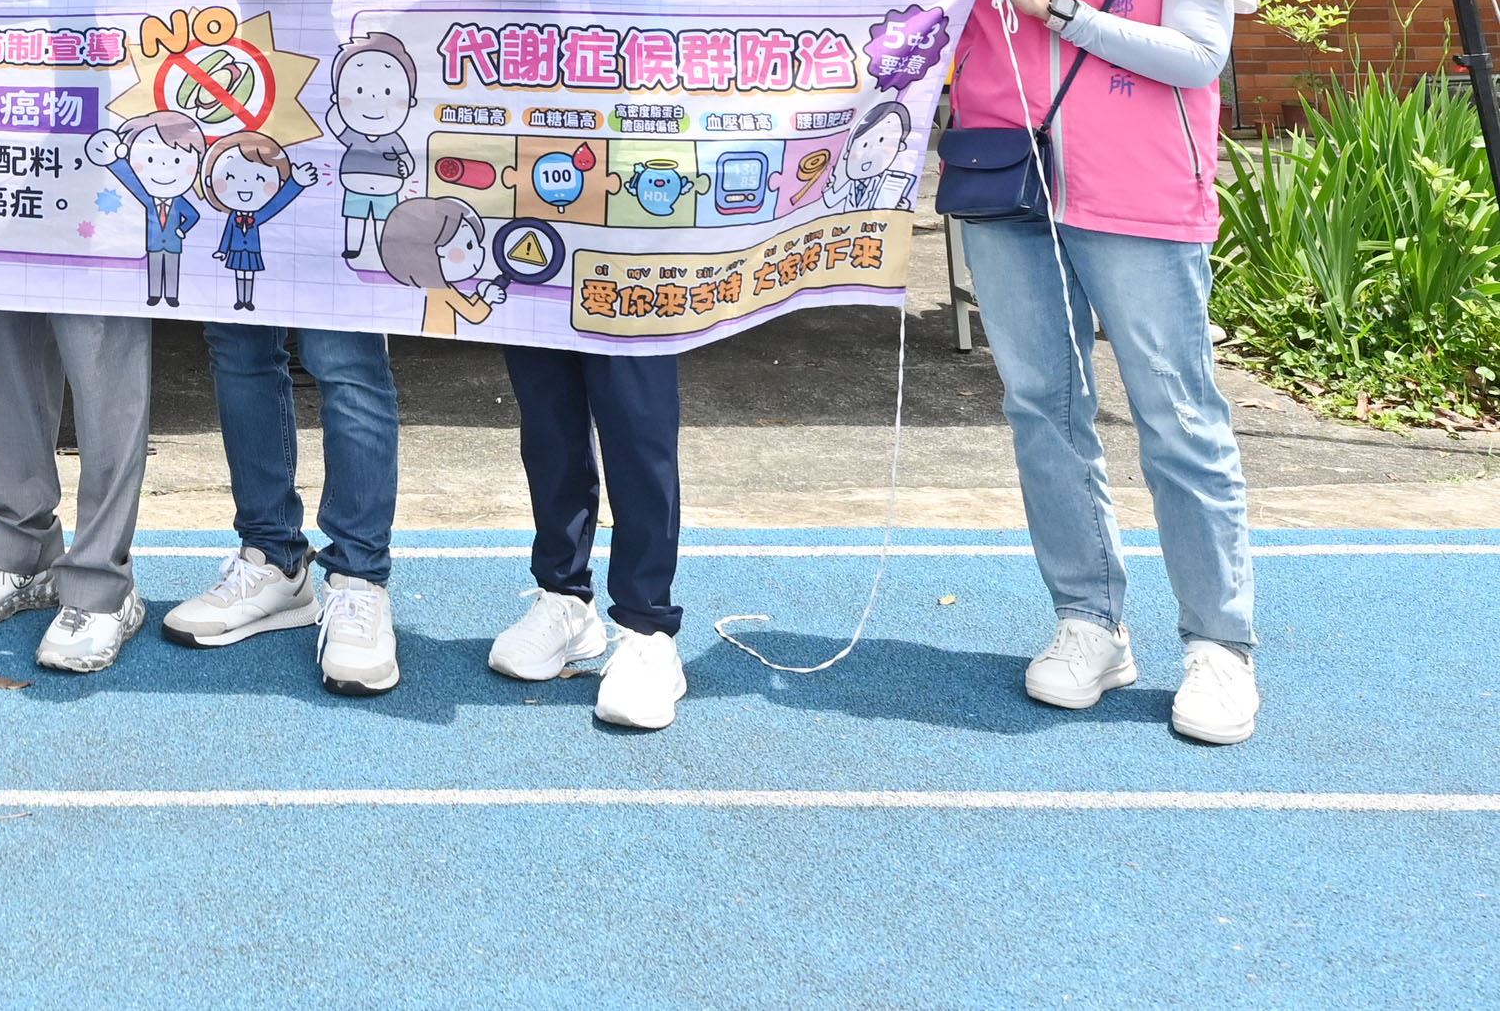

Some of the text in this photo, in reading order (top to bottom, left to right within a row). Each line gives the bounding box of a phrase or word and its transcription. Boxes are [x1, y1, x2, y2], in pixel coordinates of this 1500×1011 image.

[140, 6, 237, 58] NO
[438, 23, 856, 90] 代謝症候群防治
[440, 106, 507, 126] 血脂偏高
[529, 109, 596, 128] 血糖偏高
[615, 103, 685, 119] 高密度脂蛋白
[795, 109, 853, 130] 腰圍肥胖
[621, 118, 680, 133] 膽固醇偏低
[706, 112, 773, 131] 血壓偏高
[542, 168, 572, 184] 100
[643, 190, 671, 203] HDL
[580, 271, 743, 319] 愛你來支持
